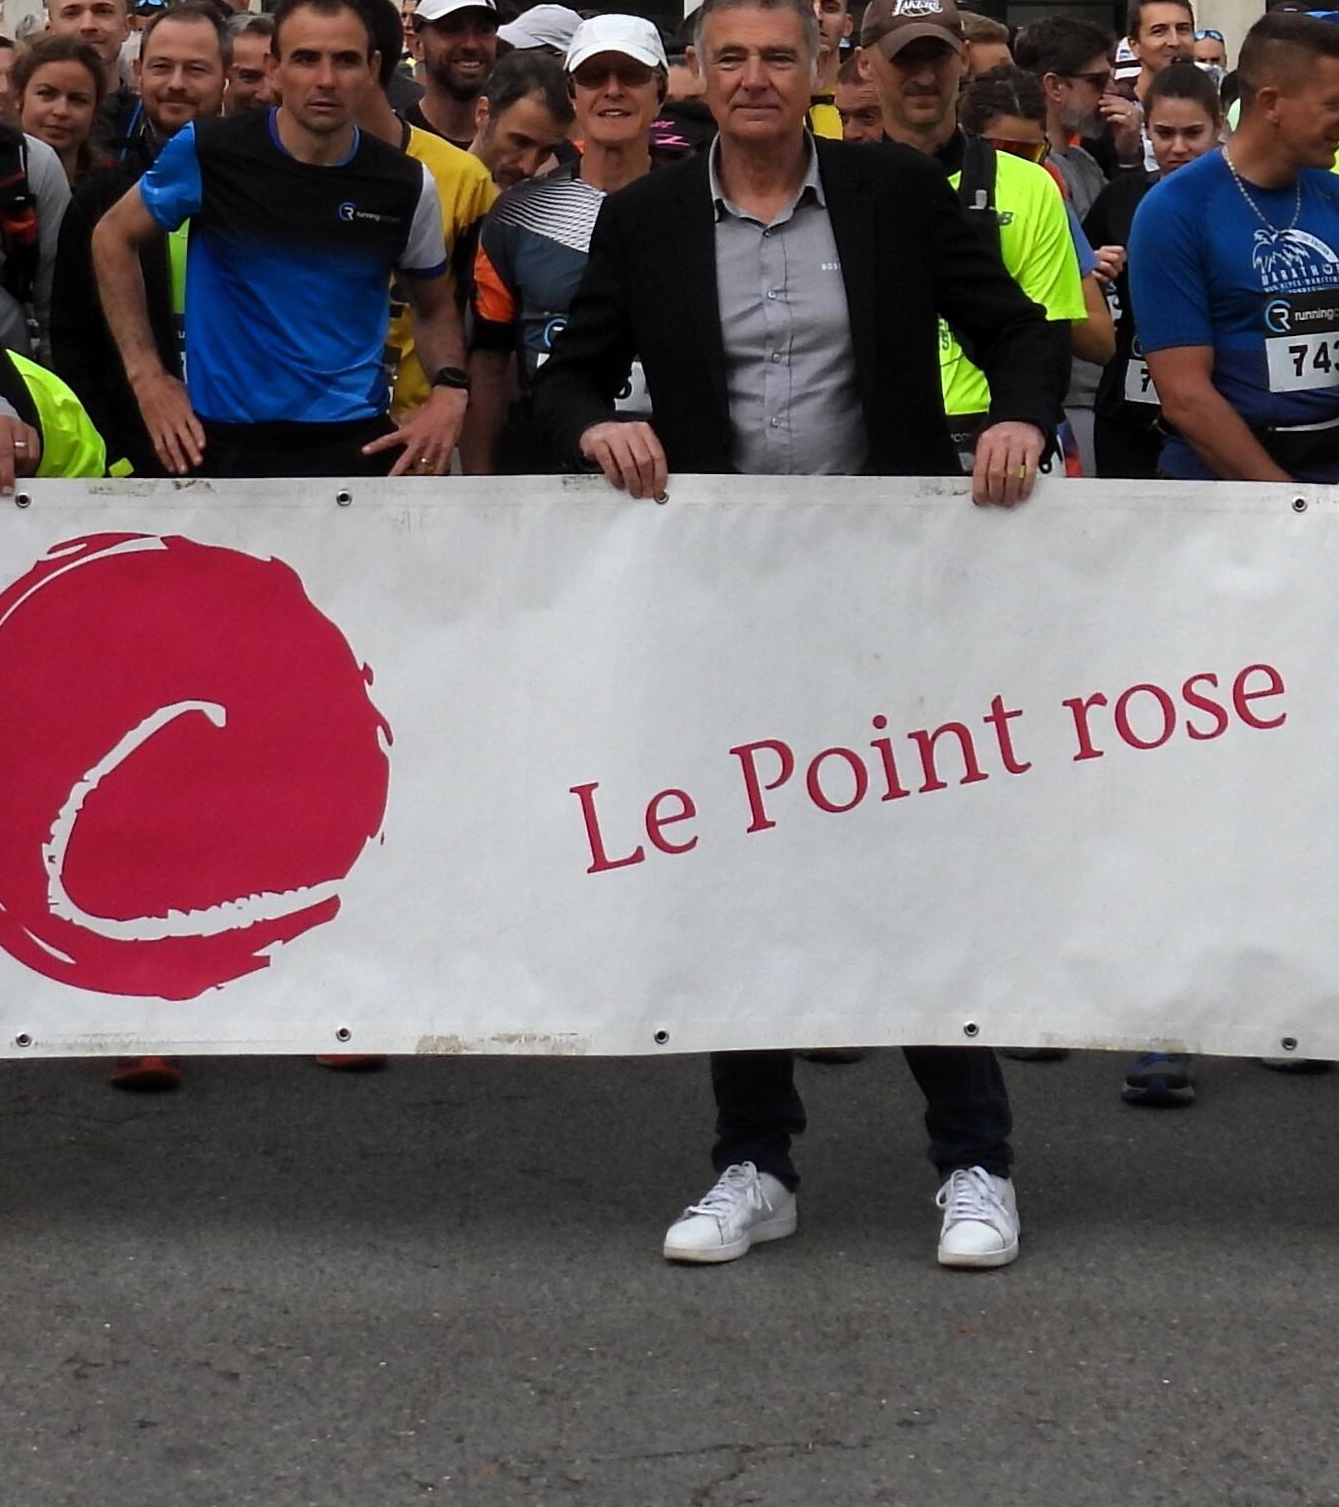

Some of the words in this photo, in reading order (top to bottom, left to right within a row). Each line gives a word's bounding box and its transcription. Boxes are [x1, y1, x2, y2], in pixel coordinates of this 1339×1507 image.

[570, 783, 697, 873] Le
[729, 694, 1032, 834] Point
[1063, 664, 1288, 761] rose
